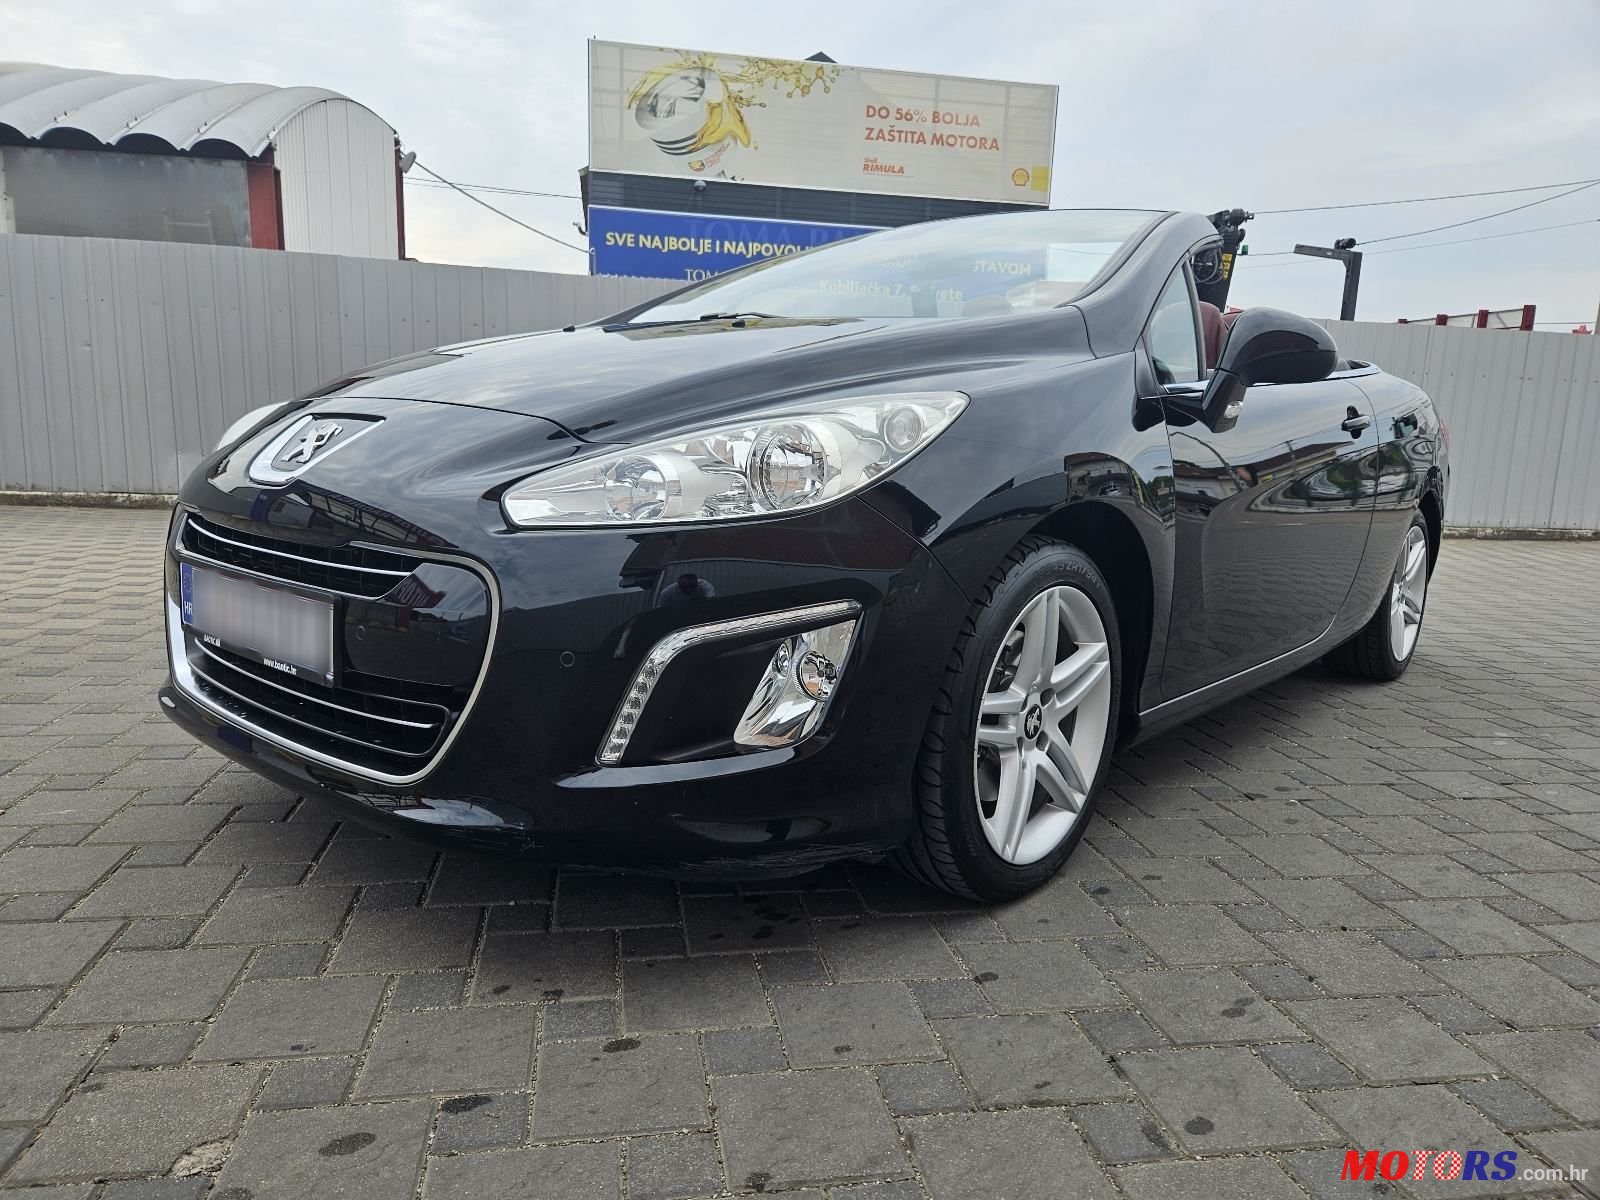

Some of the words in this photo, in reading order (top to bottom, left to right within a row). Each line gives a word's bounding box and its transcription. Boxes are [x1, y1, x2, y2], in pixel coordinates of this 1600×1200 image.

[865, 104, 890, 120] DO
[894, 107, 928, 123] 56%
[931, 110, 981, 128] BOLJA
[864, 124, 927, 145] ZAŠTITA
[930, 132, 1000, 151] MOTORA
[862, 163, 905, 175] RIMULA
[605, 231, 635, 247] SVE
[638, 233, 712, 255] NAJBOLJE
[715, 239, 720, 254] I
